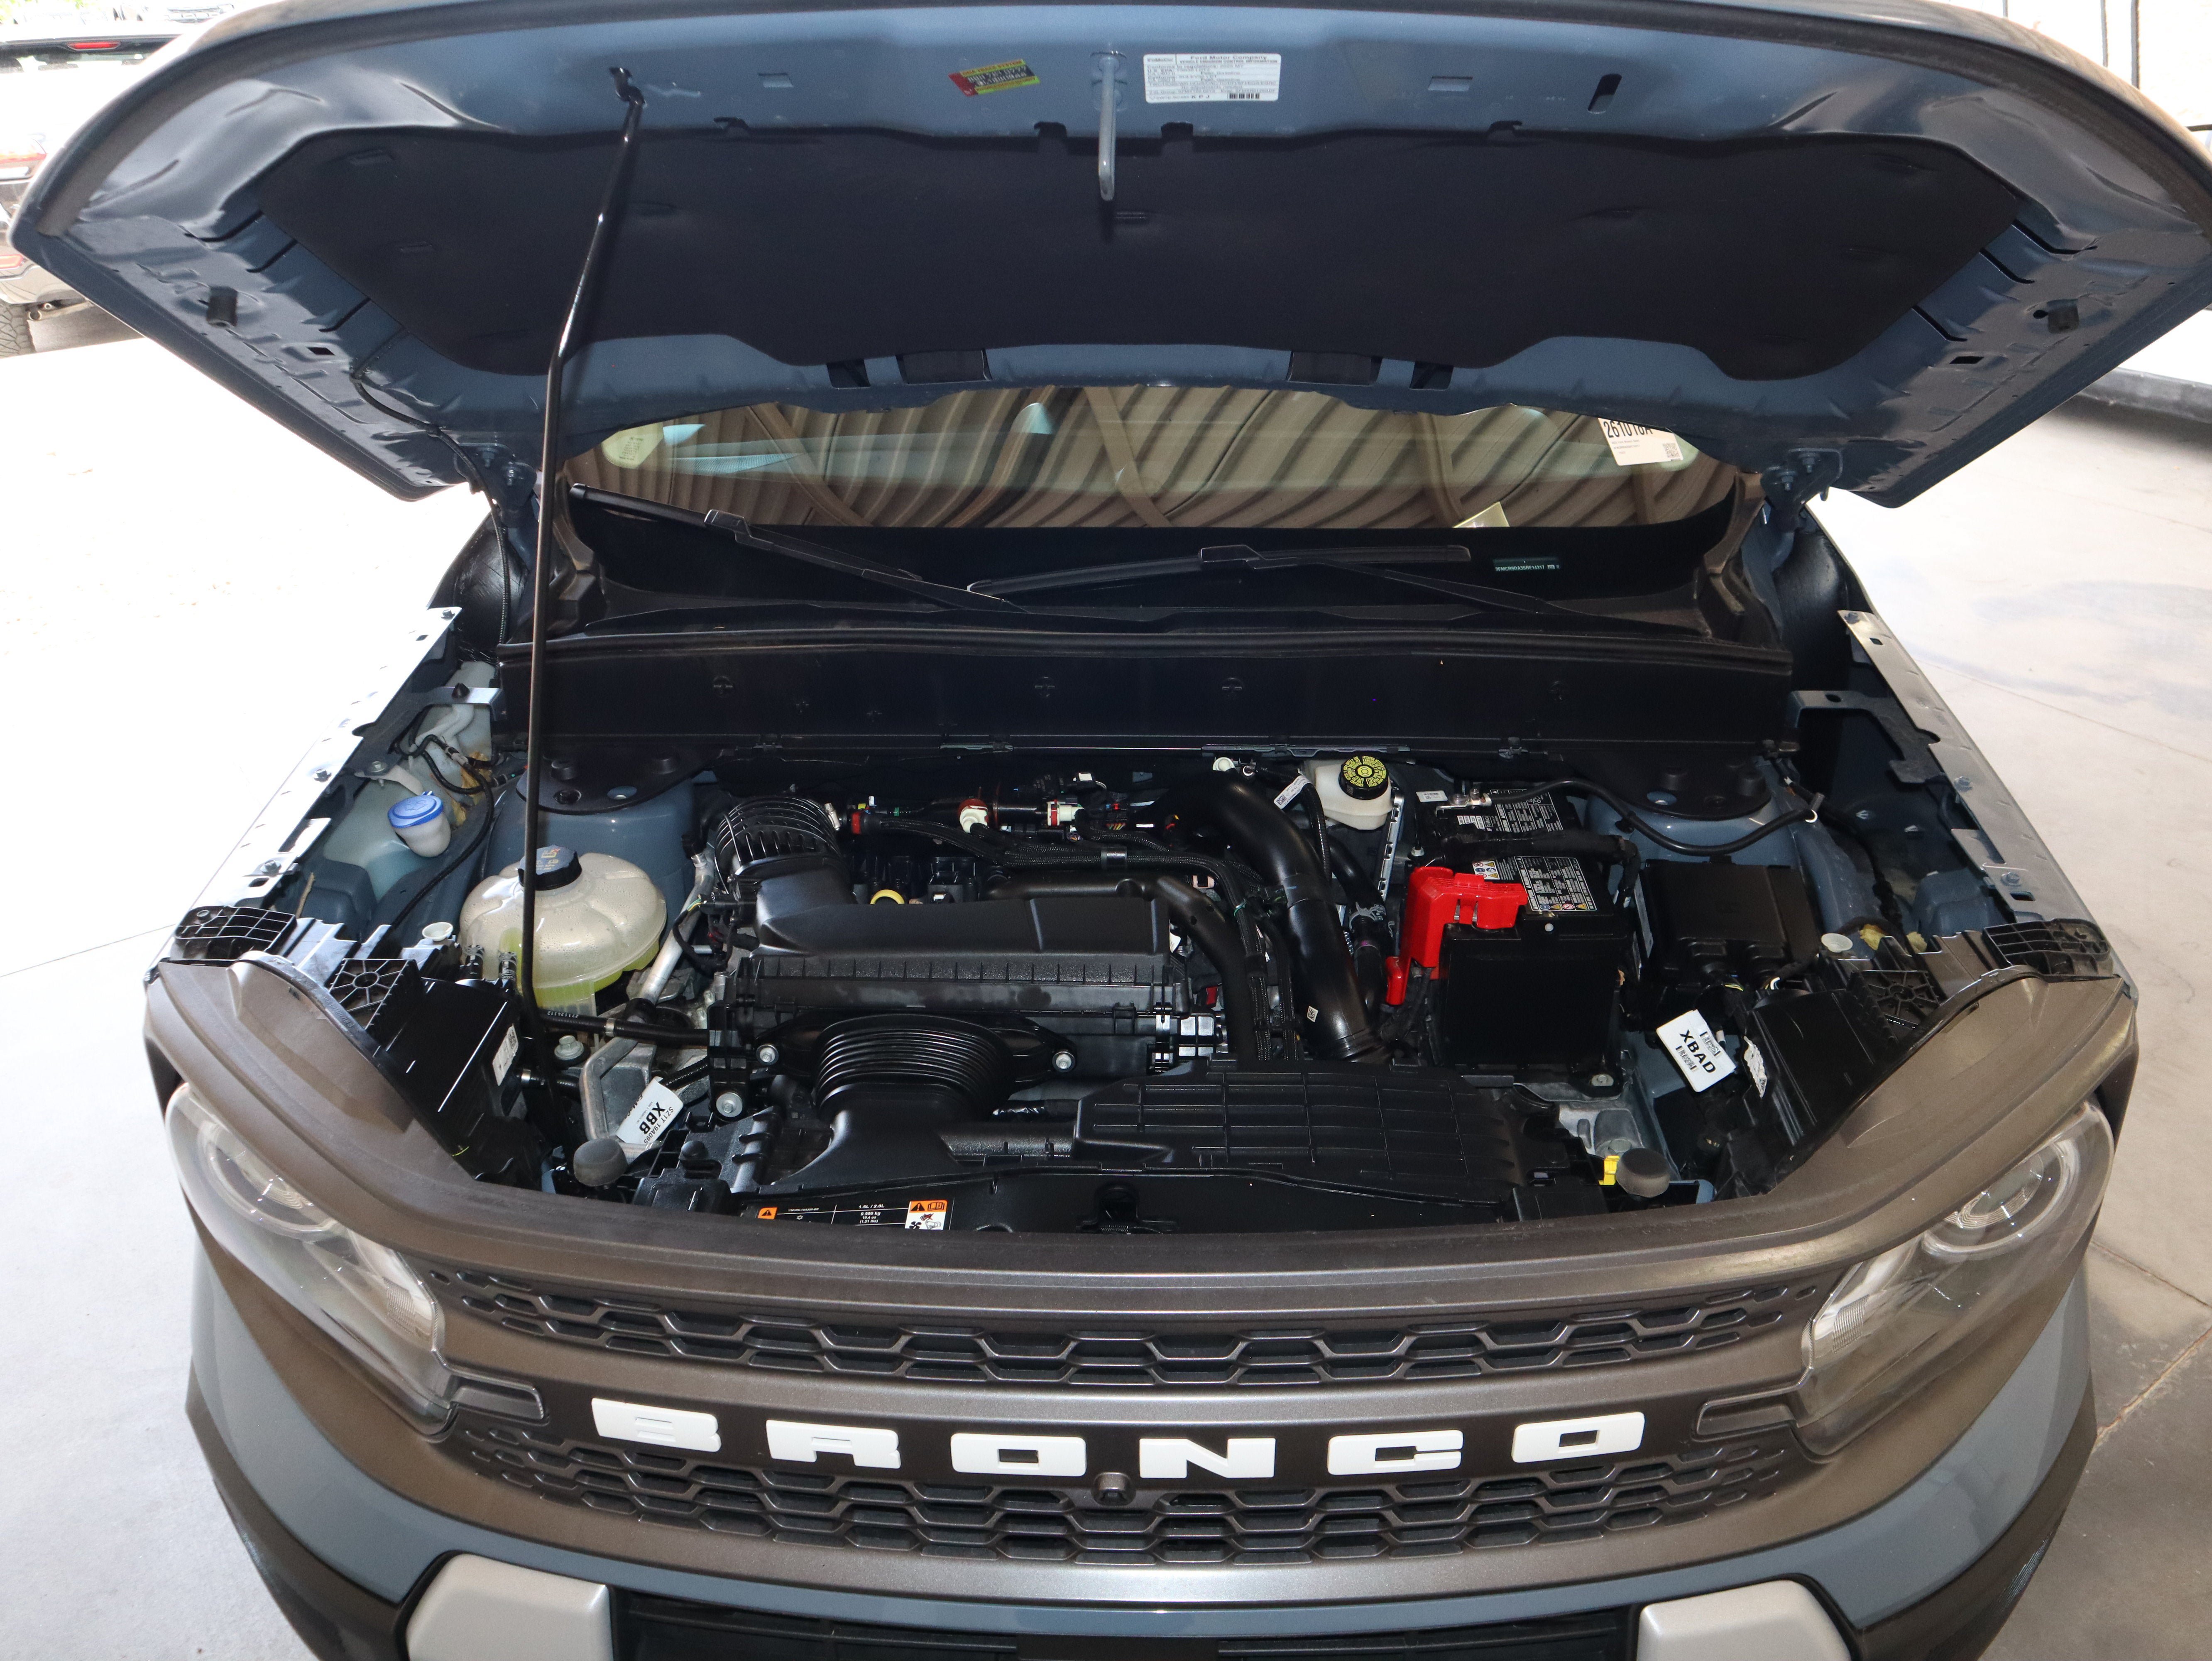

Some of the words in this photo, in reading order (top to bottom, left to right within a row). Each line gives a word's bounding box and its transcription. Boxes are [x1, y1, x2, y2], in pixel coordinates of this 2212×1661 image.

[1679, 1029, 1716, 1073] XBAD
[639, 1102, 665, 1134] XBB
[590, 1411, 1647, 1480] BRONCO
